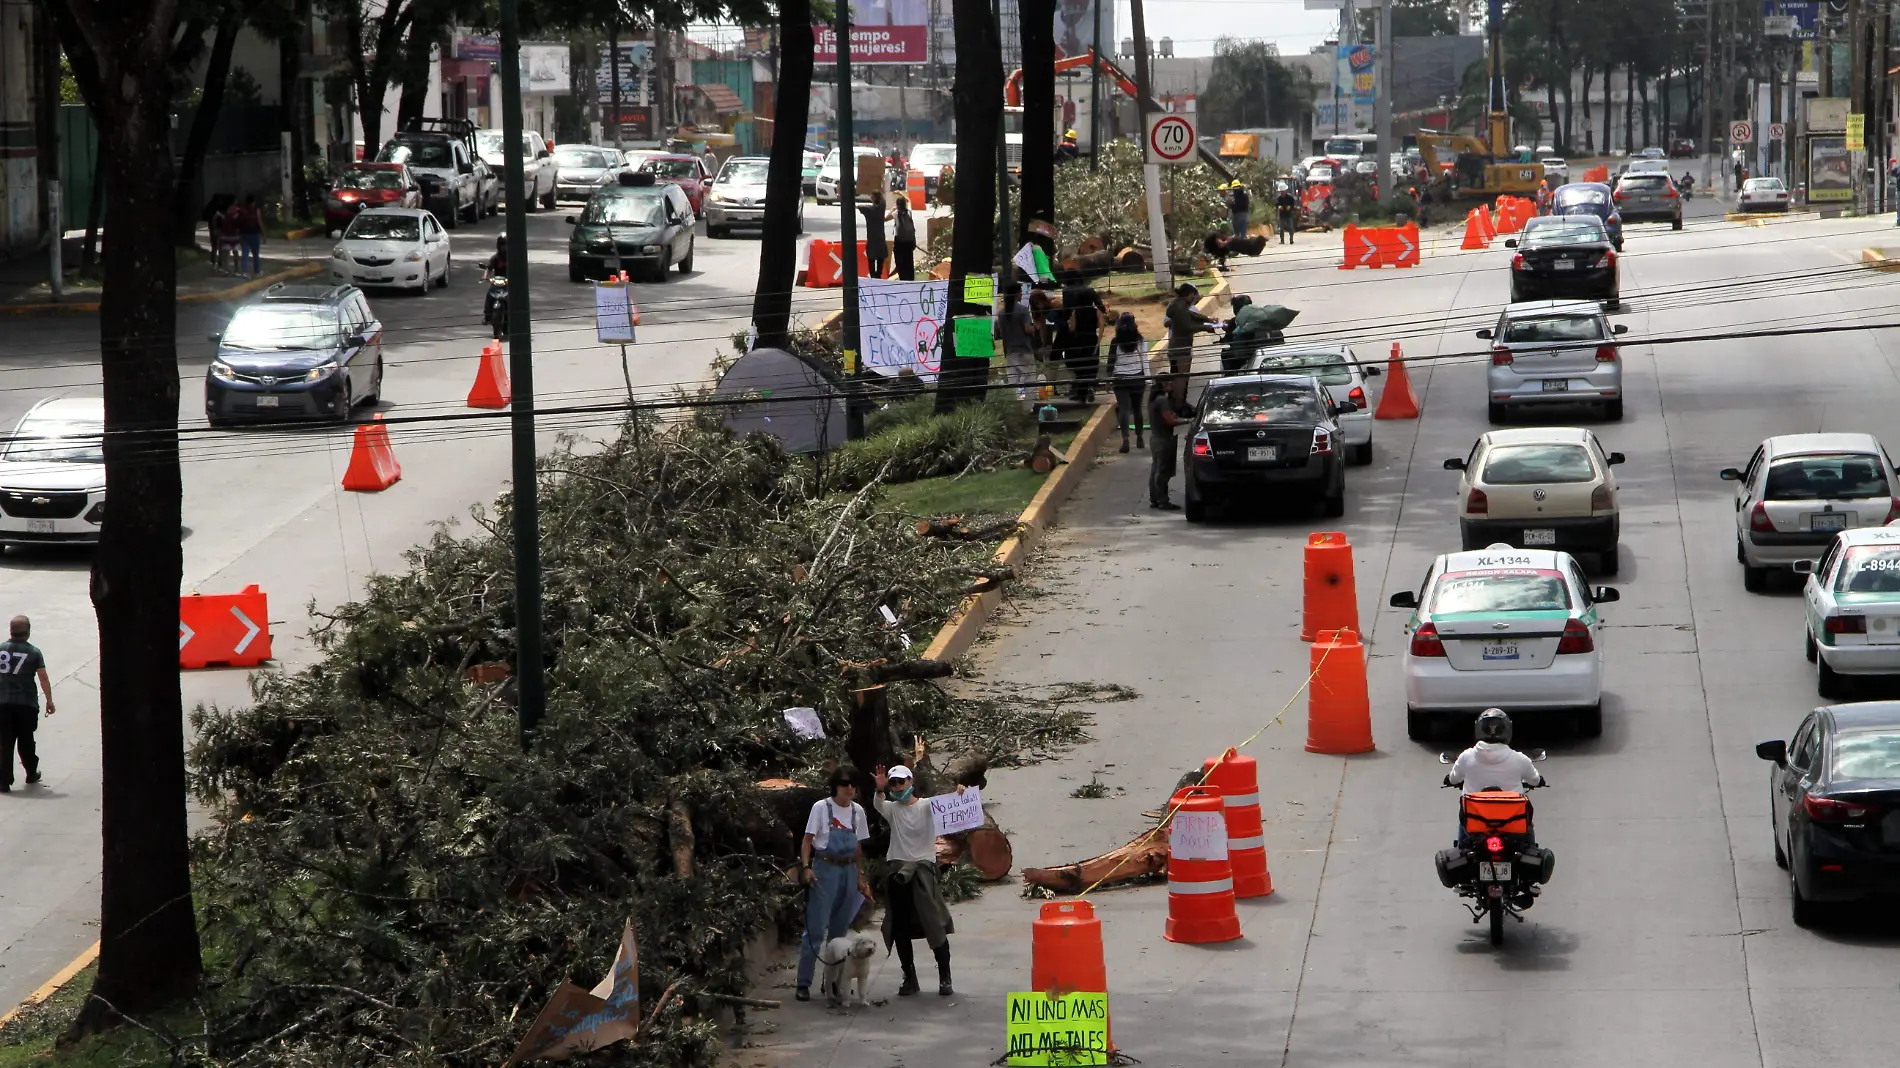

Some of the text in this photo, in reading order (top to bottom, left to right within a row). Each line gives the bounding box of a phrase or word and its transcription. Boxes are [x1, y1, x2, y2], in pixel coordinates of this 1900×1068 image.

[848, 31, 890, 43] iempo
[824, 42, 836, 53] la
[850, 41, 905, 55] mujeres!
[1162, 125, 1184, 144] 70
[1478, 556, 1531, 566] XL-1344
[0, 650, 28, 674] 87
[930, 799, 947, 815] No
[942, 805, 977, 829] FIRMA!!
[1175, 815, 1219, 832] FIRMA
[1011, 998, 1105, 1022] NI UNO MAS
[1010, 1030, 1104, 1058] NO ME TALES
